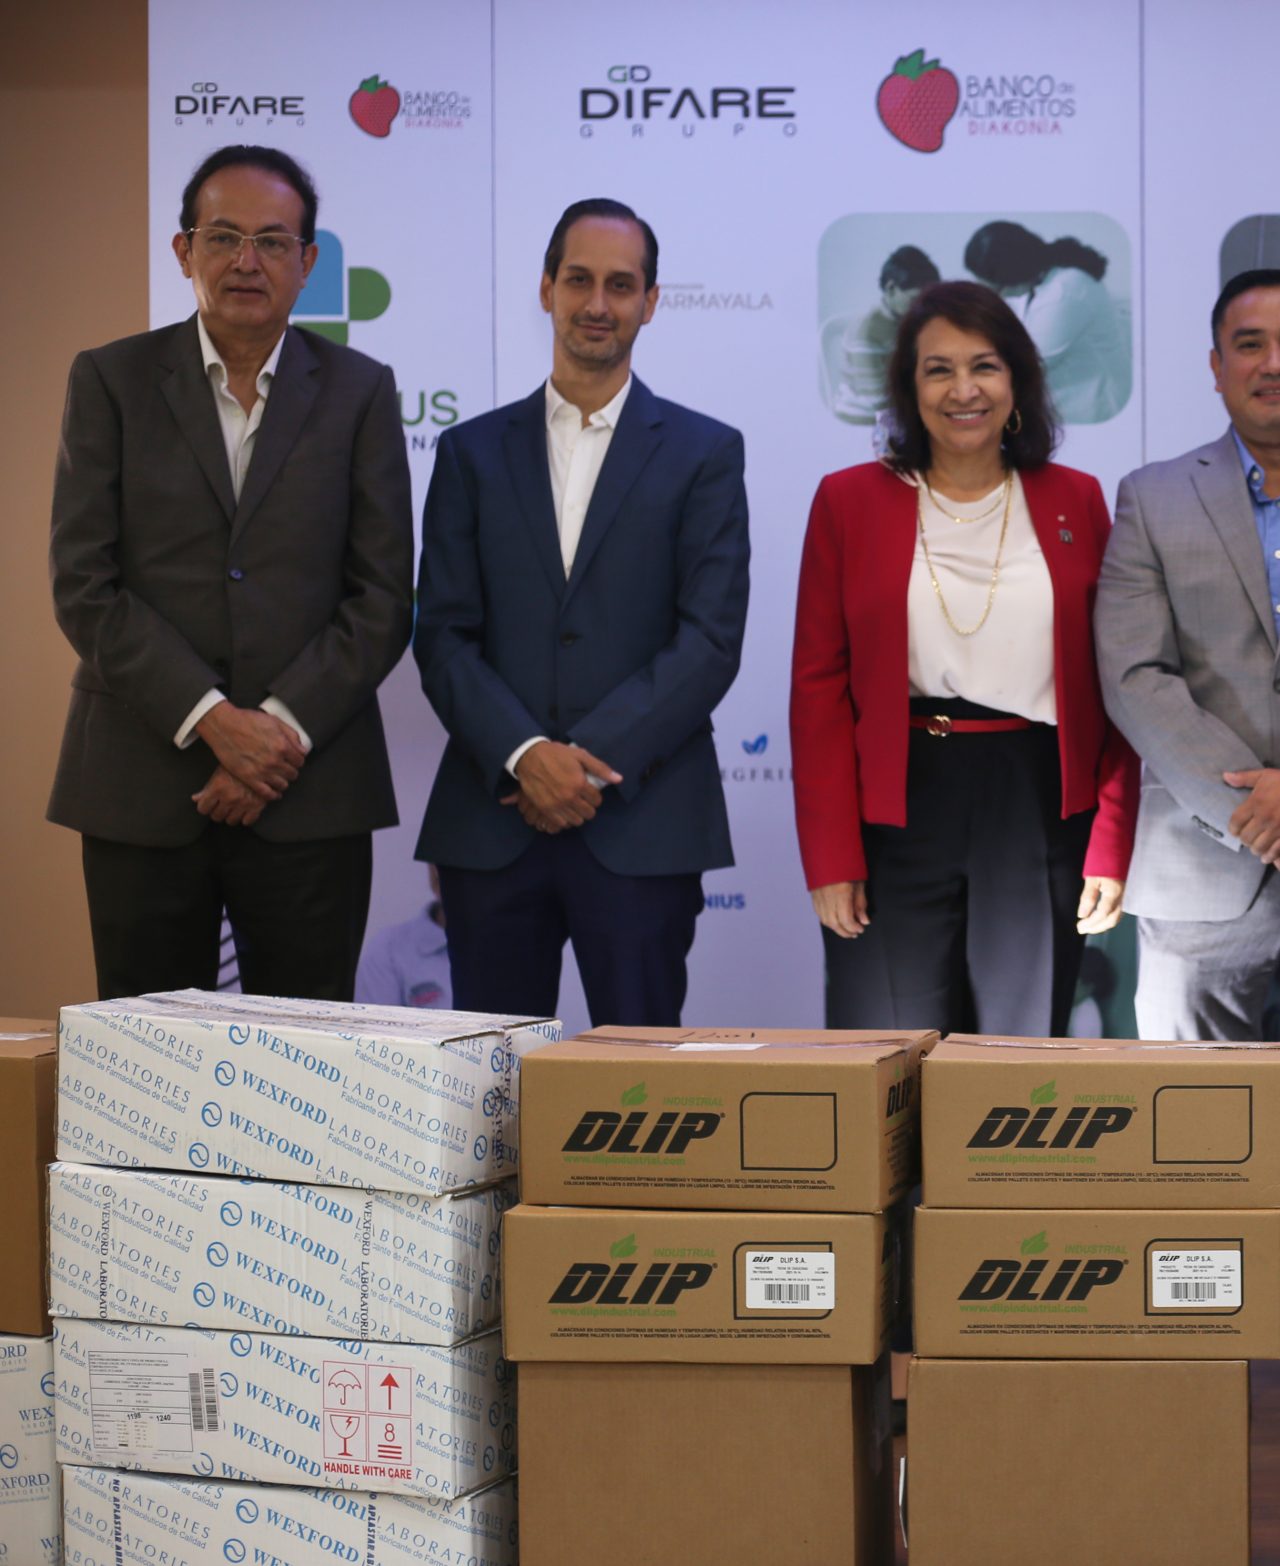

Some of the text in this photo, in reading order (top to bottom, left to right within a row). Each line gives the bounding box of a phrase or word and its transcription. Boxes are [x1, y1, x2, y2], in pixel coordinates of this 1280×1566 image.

[174, 95, 305, 116] DIFARE
[403, 91, 458, 105] BANCO
[580, 88, 796, 120] DIFARE
[966, 75, 1056, 99] BANCO
[175, 117, 305, 127] GRUPO
[400, 106, 472, 118] ALIMENTOS
[959, 99, 1077, 118] ALIMENTOS
[580, 123, 797, 139] GRUPO
[659, 292, 775, 311] ARMAYALA
[65, 1031, 191, 1103] LABORATORIES
[256, 1027, 468, 1144] WEXFORD LABORATORIES
[662, 1096, 724, 1107] INDUSTRIAL
[1074, 1094, 1137, 1104] INDUSTRIAL
[229, 1111, 315, 1167] WEXFORD
[242, 1069, 459, 1188] WEXFORD LABORATORIES
[561, 1111, 721, 1154] DLIP
[966, 1106, 1134, 1149] DLIP
[272, 1184, 354, 1224] EXFORD
[100, 1201, 110, 1257] WEXFORD
[249, 1210, 340, 1266] WEXFORD
[1064, 1243, 1128, 1254] INDUSTRIAL
[360, 1200, 373, 1340] WEXFORD LABORATORIE
[654, 1248, 717, 1259] INDUSTRIAL
[236, 1250, 326, 1307] WEXFORD
[547, 1263, 713, 1305] DLIP
[957, 1259, 1125, 1301] DLIP
[259, 1341, 321, 1384] WEXFO
[245, 1381, 321, 1433] WEXFOR
[232, 1422, 321, 1478] WEXFORD
[384, 1423, 396, 1442] 8
[323, 1462, 412, 1480] HANDLE WITH CARE
[112, 1478, 123, 1543] NO APLASTAR
[266, 1507, 360, 1564] WEXFORD
